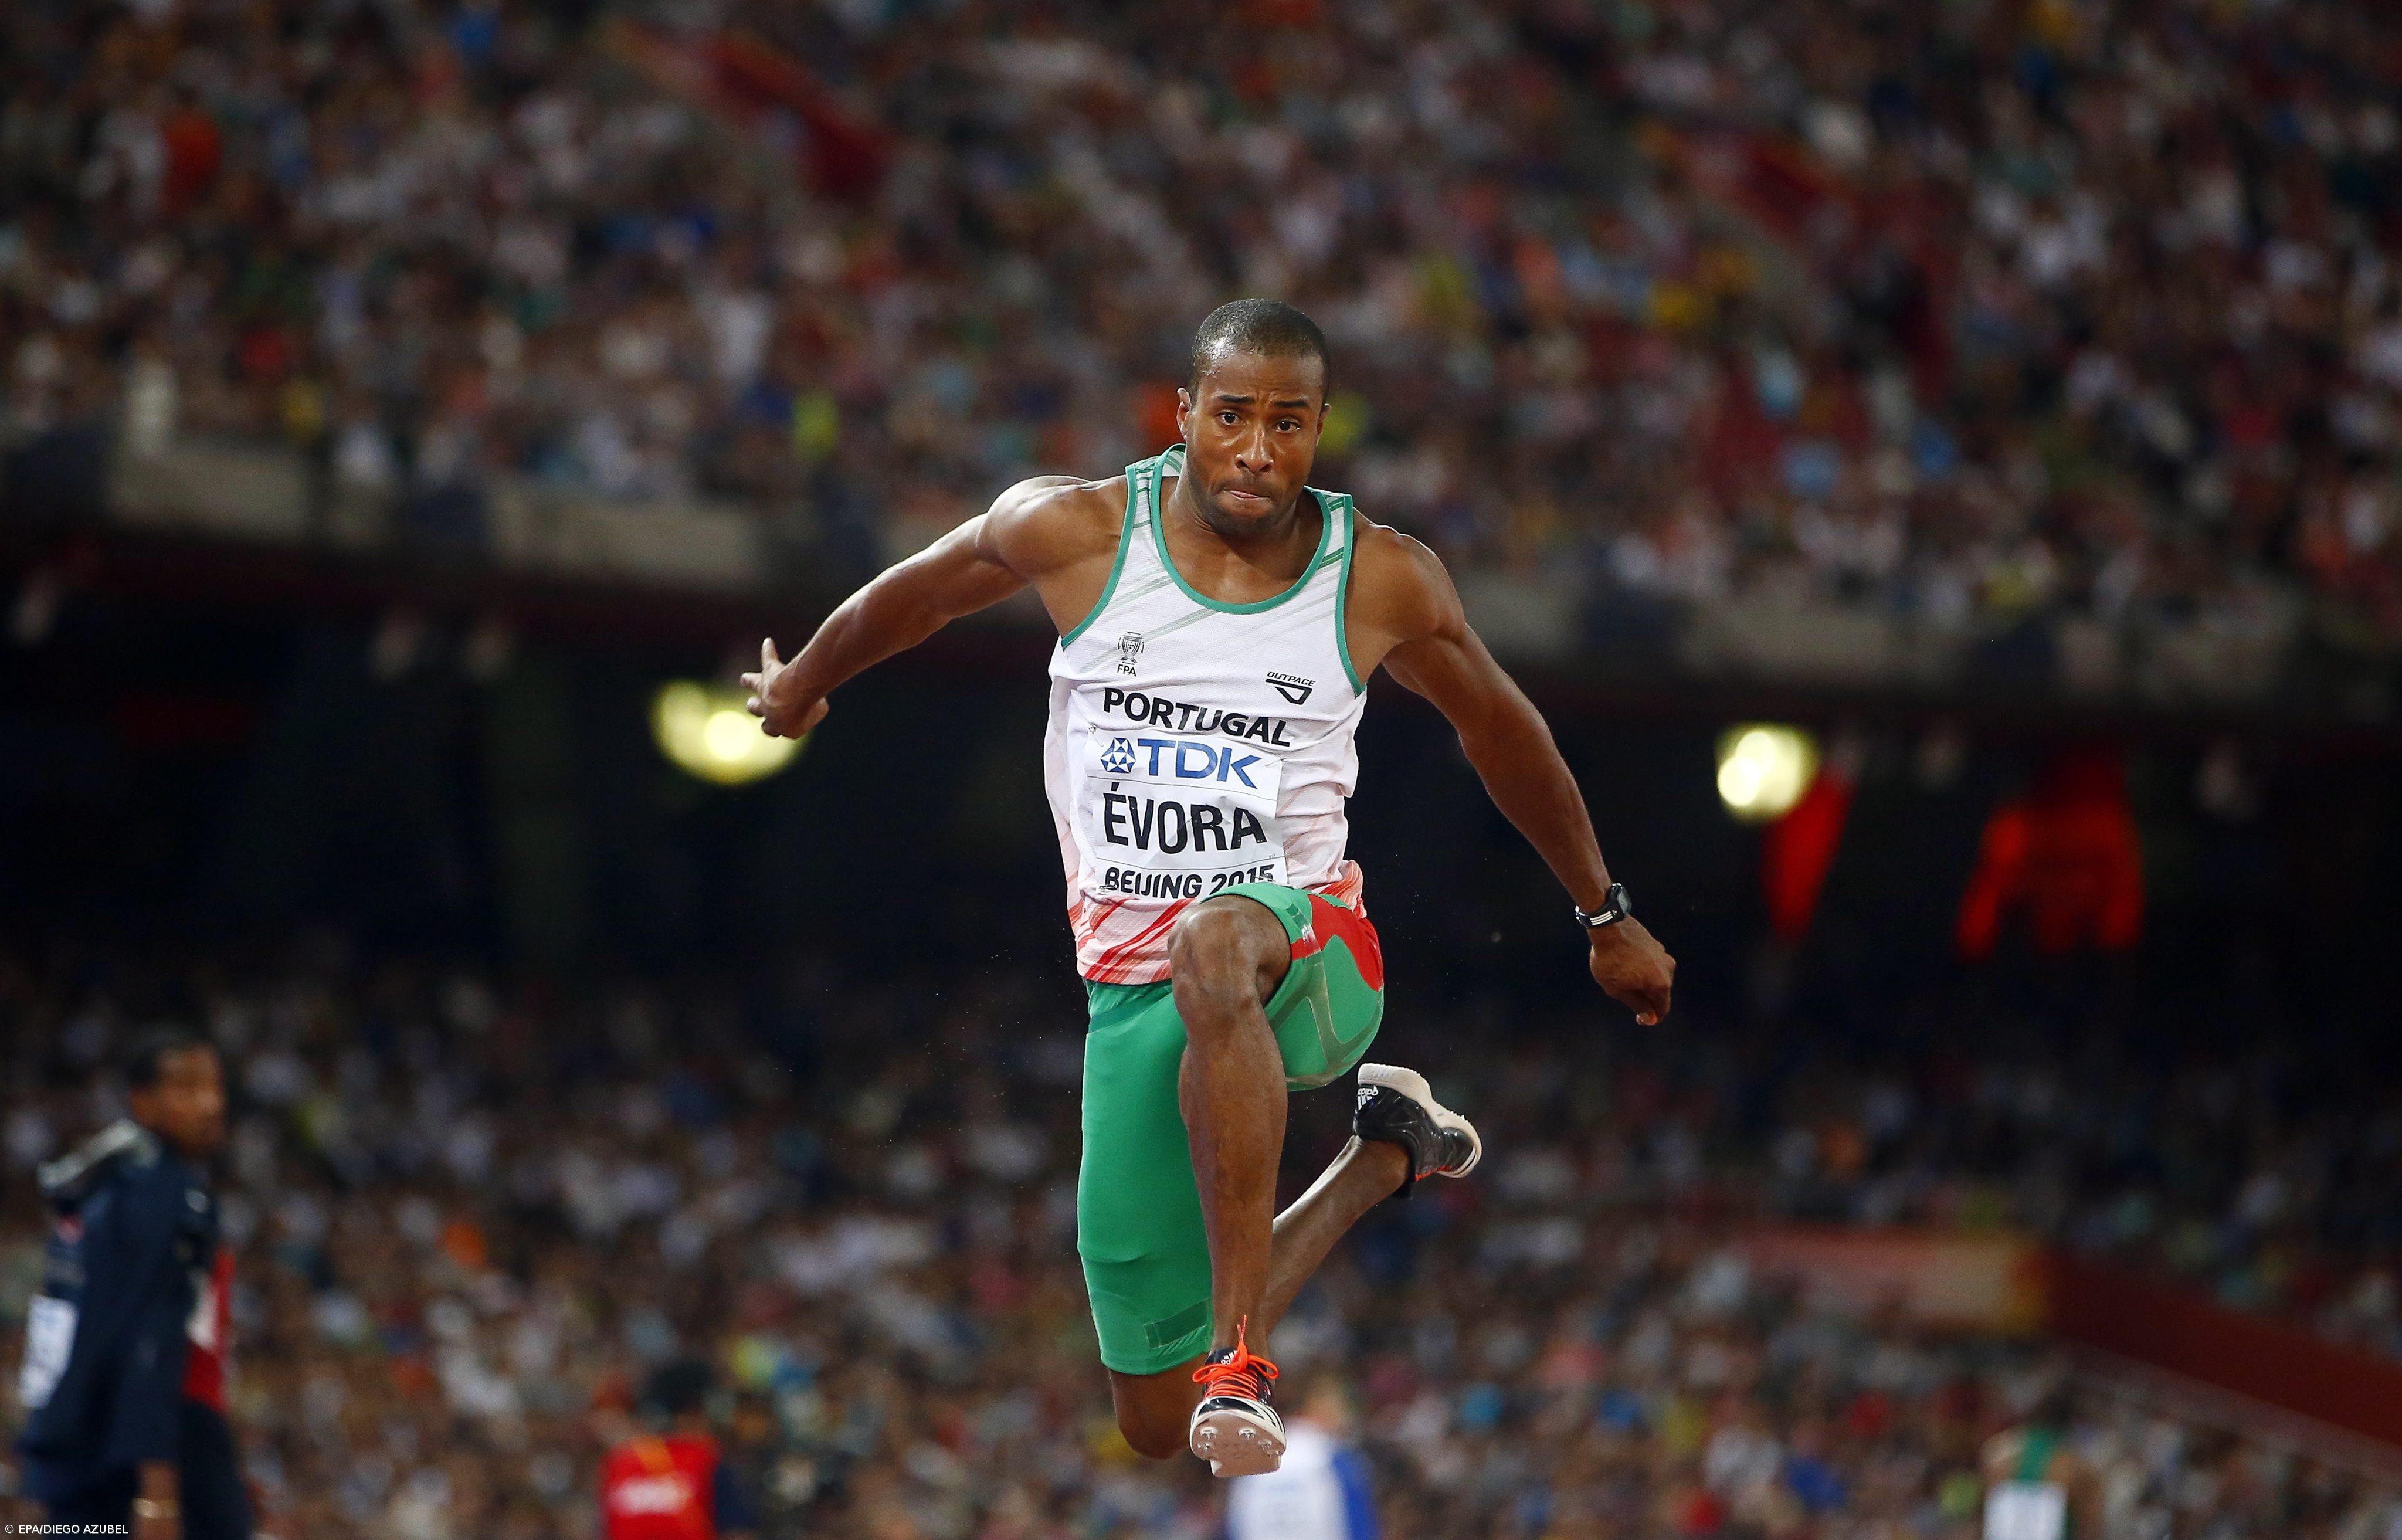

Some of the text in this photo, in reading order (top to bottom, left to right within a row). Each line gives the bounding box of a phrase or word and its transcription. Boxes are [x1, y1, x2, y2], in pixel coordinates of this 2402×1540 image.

[1117, 664, 1136, 677] FPA
[1267, 671, 1316, 687] OUTPACE
[1104, 687, 1290, 747] PORTUGAL
[1138, 738, 1262, 789] TDK
[1103, 782, 1267, 854] ÉVORA
[1105, 864, 1275, 898] BEIJING 2015
